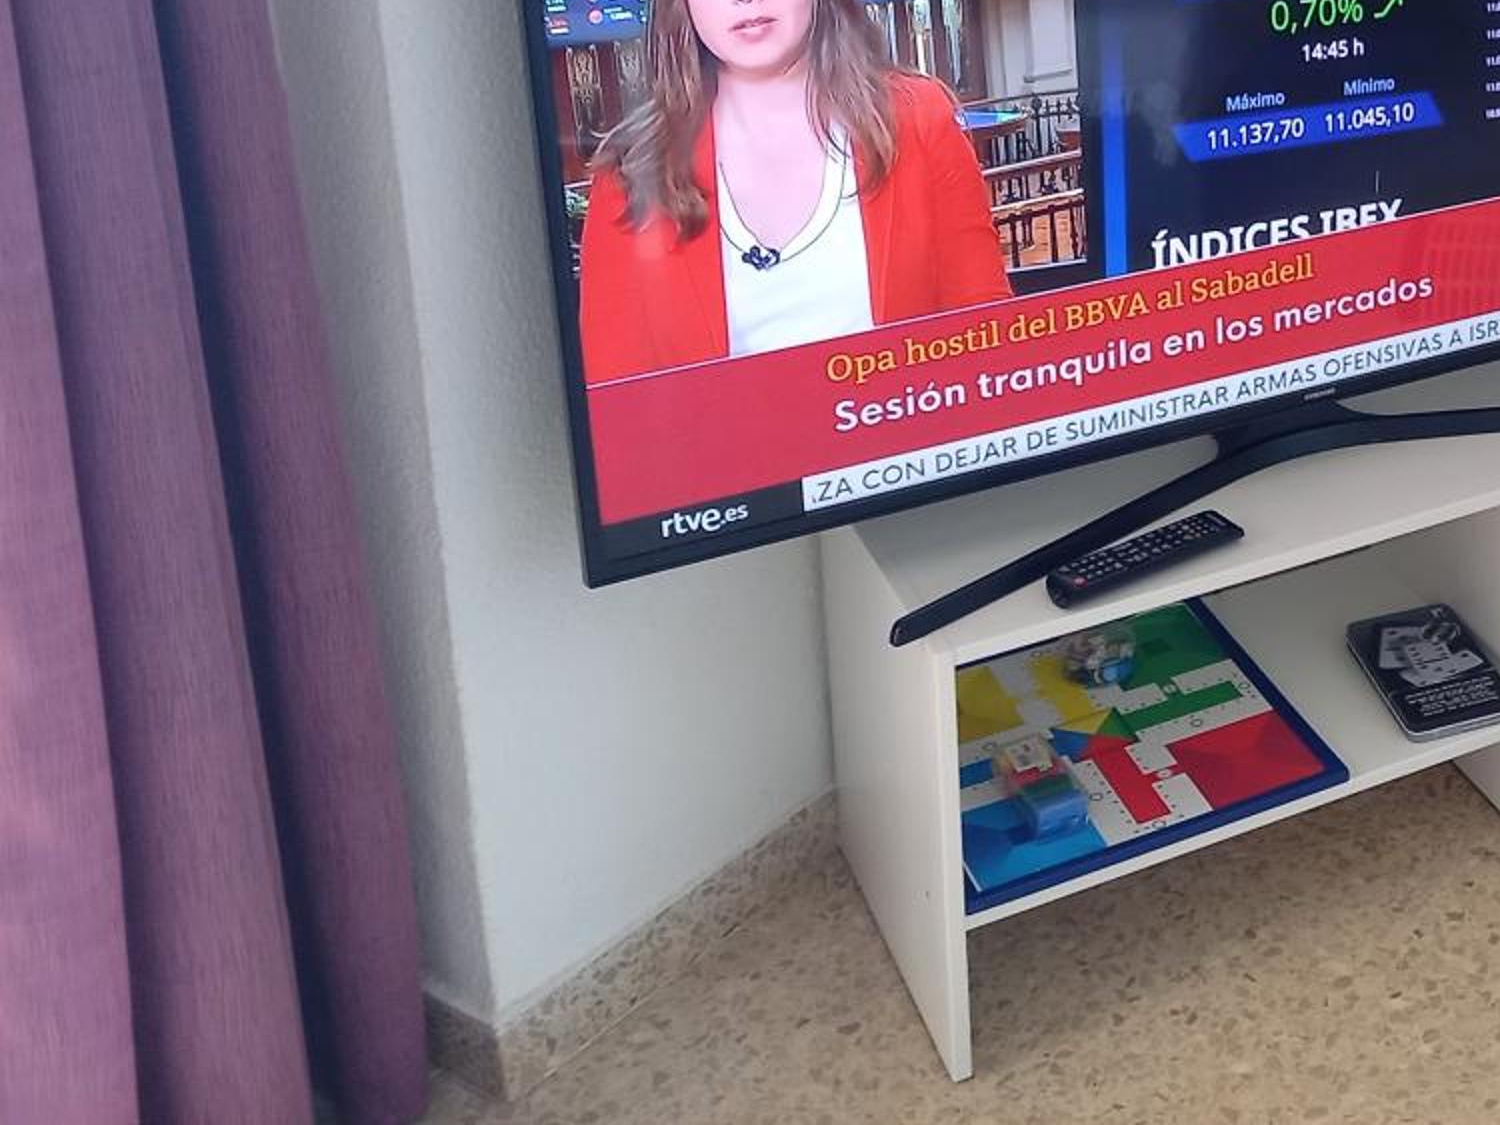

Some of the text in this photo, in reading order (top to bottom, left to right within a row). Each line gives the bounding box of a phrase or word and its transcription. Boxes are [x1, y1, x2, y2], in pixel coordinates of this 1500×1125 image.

[1301, 36, 1364, 63] 14:45 h
[1207, 102, 1416, 150] 11.137,70 11.045,10
[1225, 91, 1285, 112] Máximo
[1151, 214, 1313, 270] ÍNDICES
[826, 252, 1316, 384] Opa hostil del BBVA al Sabadell
[834, 276, 1434, 432] Sesión tranquila en los mercados
[862, 458, 926, 490] CON
[934, 435, 1018, 473] DEJAR
[1026, 426, 1058, 452] DE
[1066, 386, 1229, 442] SUMINISTRAR
[1236, 364, 1317, 401] ARMAS
[1322, 329, 1443, 377] OFENSIVAS
[1449, 328, 1464, 347] A
[660, 503, 749, 539] rtve.es
